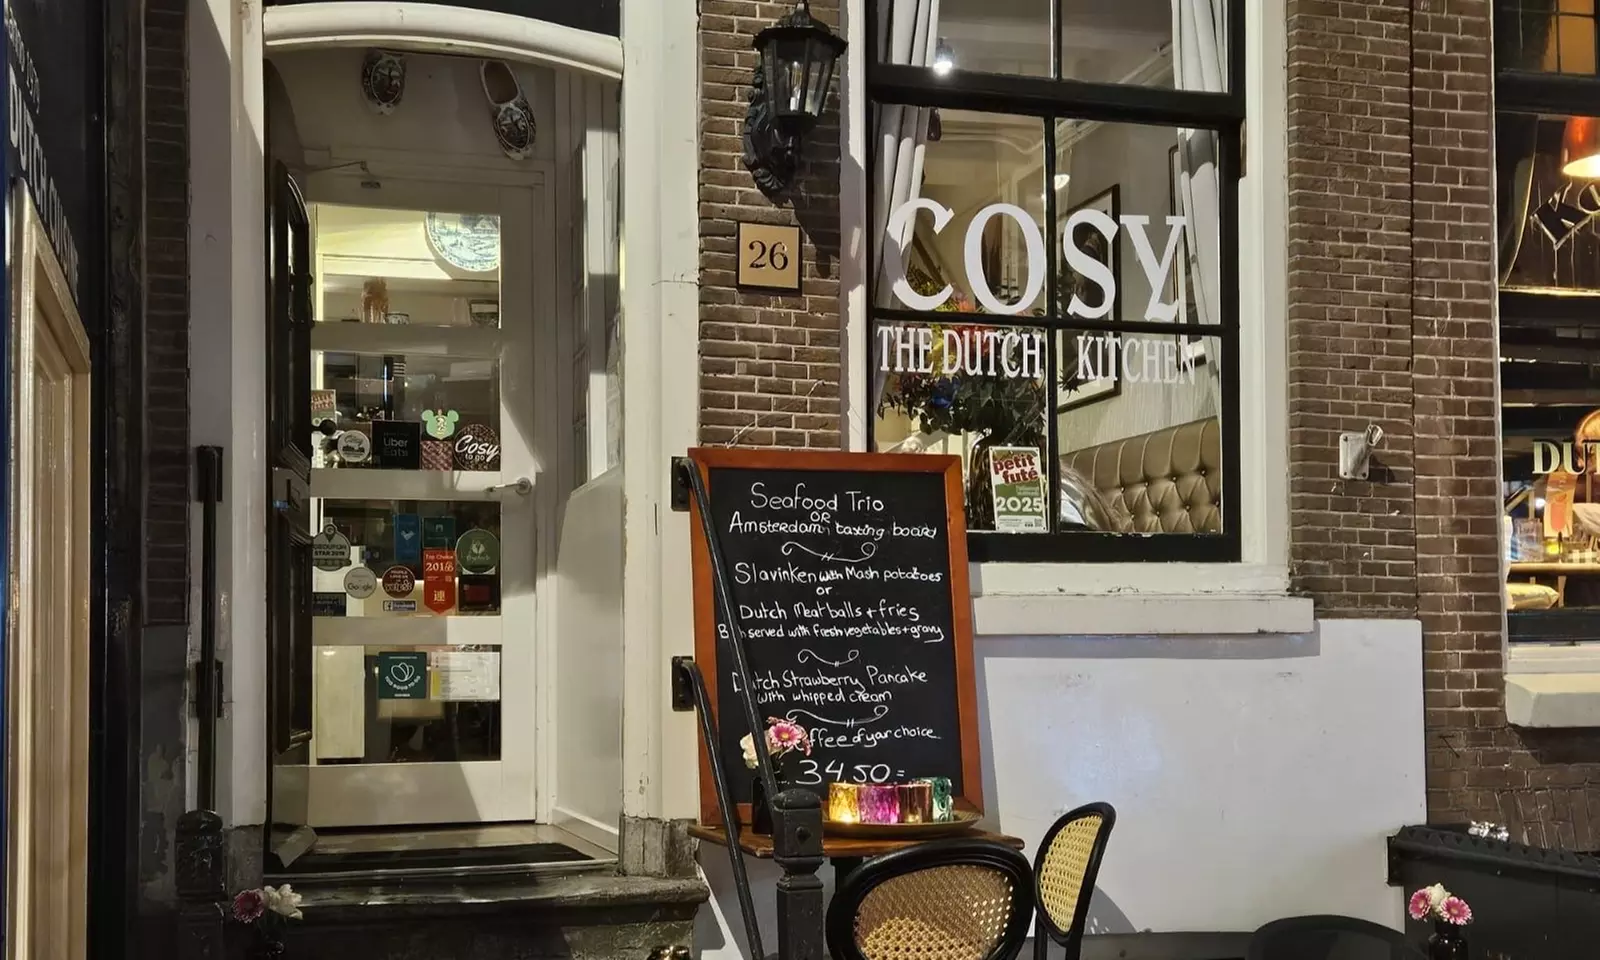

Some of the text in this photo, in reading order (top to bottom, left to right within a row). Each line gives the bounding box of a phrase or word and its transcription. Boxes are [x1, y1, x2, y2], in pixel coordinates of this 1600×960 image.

[749, 240, 788, 271] 26
[886, 197, 1187, 322] COSY
[877, 325, 1196, 386] THE DUTCH KITCHEN
[383, 438, 408, 448] Uber
[455, 435, 499, 462] Cosy
[465, 453, 485, 462] to go
[993, 453, 1035, 475] petit
[1002, 467, 1038, 484] futé
[750, 482, 884, 512] Seafood Trio
[996, 496, 1043, 512] 2025
[811, 511, 830, 523] OR
[735, 561, 943, 584] Slavinken with Mash potatoes
[347, 583, 373, 592] Google
[816, 587, 833, 595] or
[739, 602, 788, 620] Dutch
[879, 598, 920, 622] fries
[748, 624, 785, 638] served
[787, 624, 811, 638] with
[813, 621, 844, 637] fresh
[782, 668, 866, 693] Strawberry
[866, 665, 928, 686] Pancake
[757, 690, 893, 706] with whipped cream
[894, 725, 942, 740] choice
